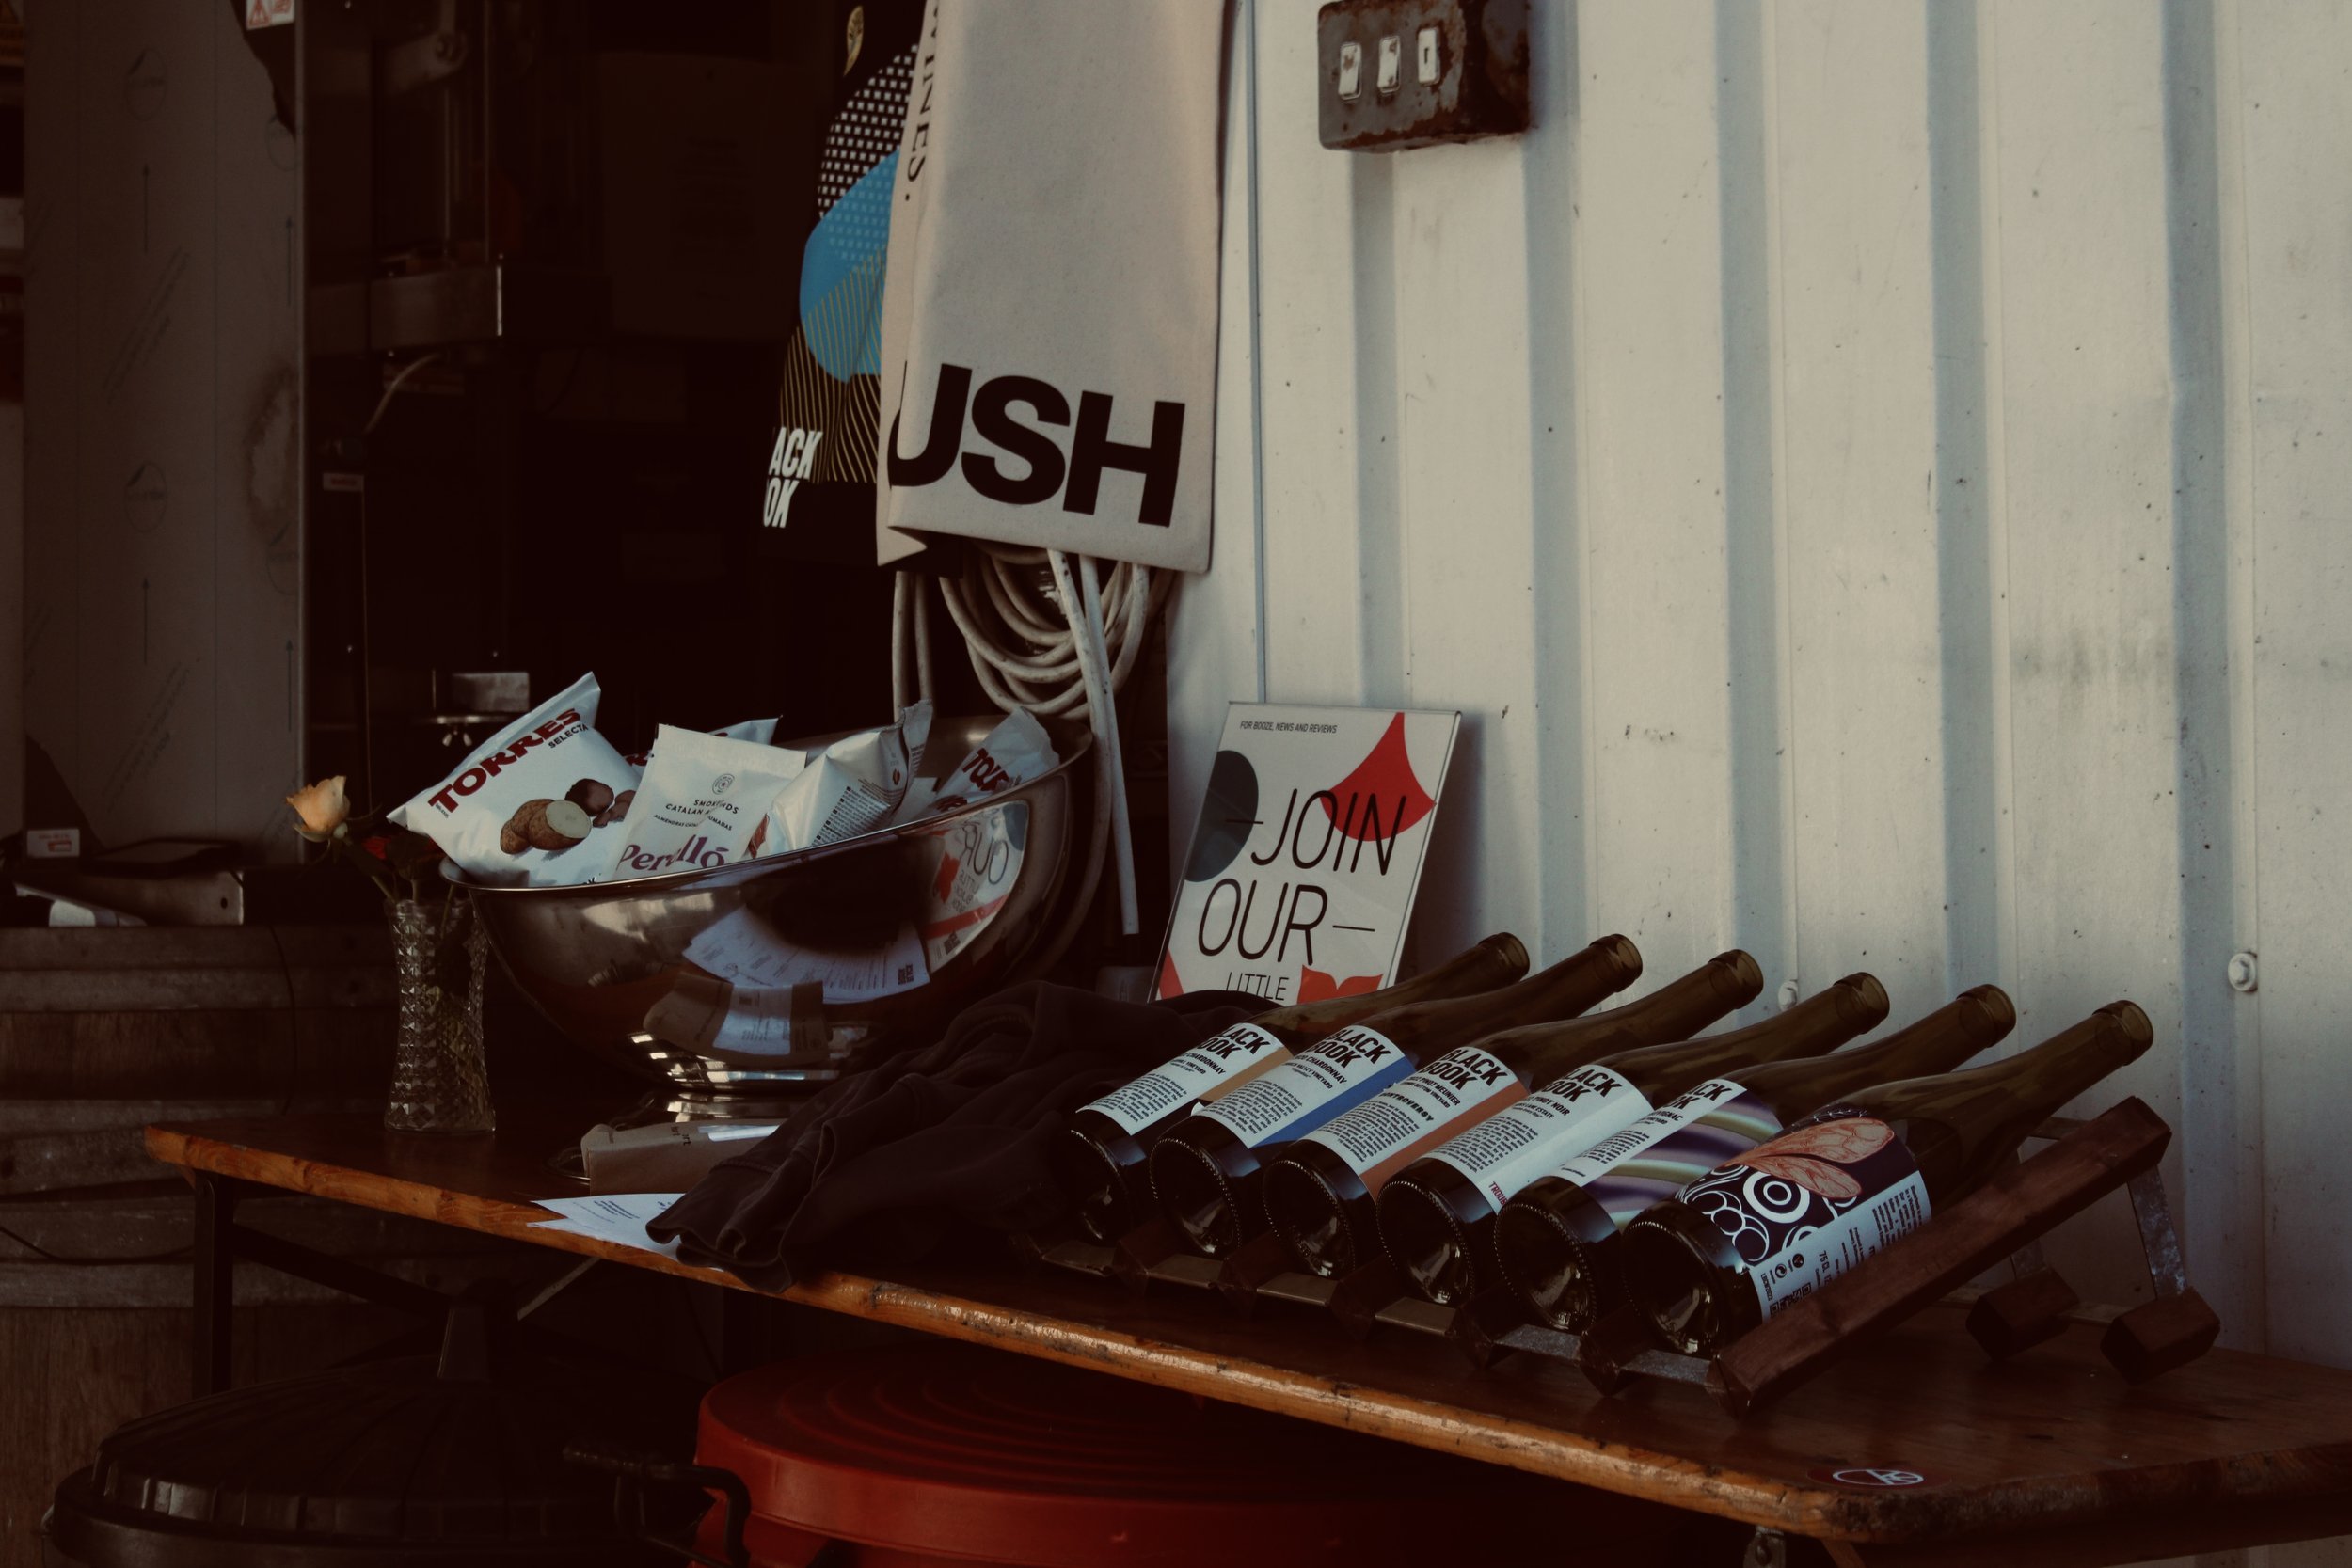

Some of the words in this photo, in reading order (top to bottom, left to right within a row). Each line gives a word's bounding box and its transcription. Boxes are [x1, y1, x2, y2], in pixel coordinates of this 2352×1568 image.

[768, 426, 824, 482] ACK
[763, 478, 800, 529] OK
[548, 723, 589, 749] SELECTA
[1240, 721, 1252, 730] FOR
[1252, 721, 1274, 731] BOOZE,
[1276, 722, 1295, 732] NEWS
[1295, 723, 1309, 732] AND
[1309, 723, 1338, 734] REVIEWS
[428, 707, 581, 813] TORRES
[665, 803, 704, 815] CATALAN
[1250, 788, 1407, 876] JOIN
[1198, 879, 1327, 966] OUR
[1196, 1037, 1242, 1059] OOK
[1217, 1025, 1272, 1054] LACK
[1305, 1056, 1347, 1084] CHARDONNAY
[1311, 1070, 1334, 1088] VINEYARD
[1418, 1060, 1477, 1090] BOOK
[1439, 1048, 1508, 1086] BLACK
[1434, 1084, 1462, 1105] MEUNIER
[1541, 1079, 1591, 1102] OOK
[1563, 1067, 1622, 1097] LACK
[1429, 1091, 1450, 1108] VINEYARD
[1549, 1101, 1571, 1116] NOIR
[1819, 1249, 1828, 1262] 75
